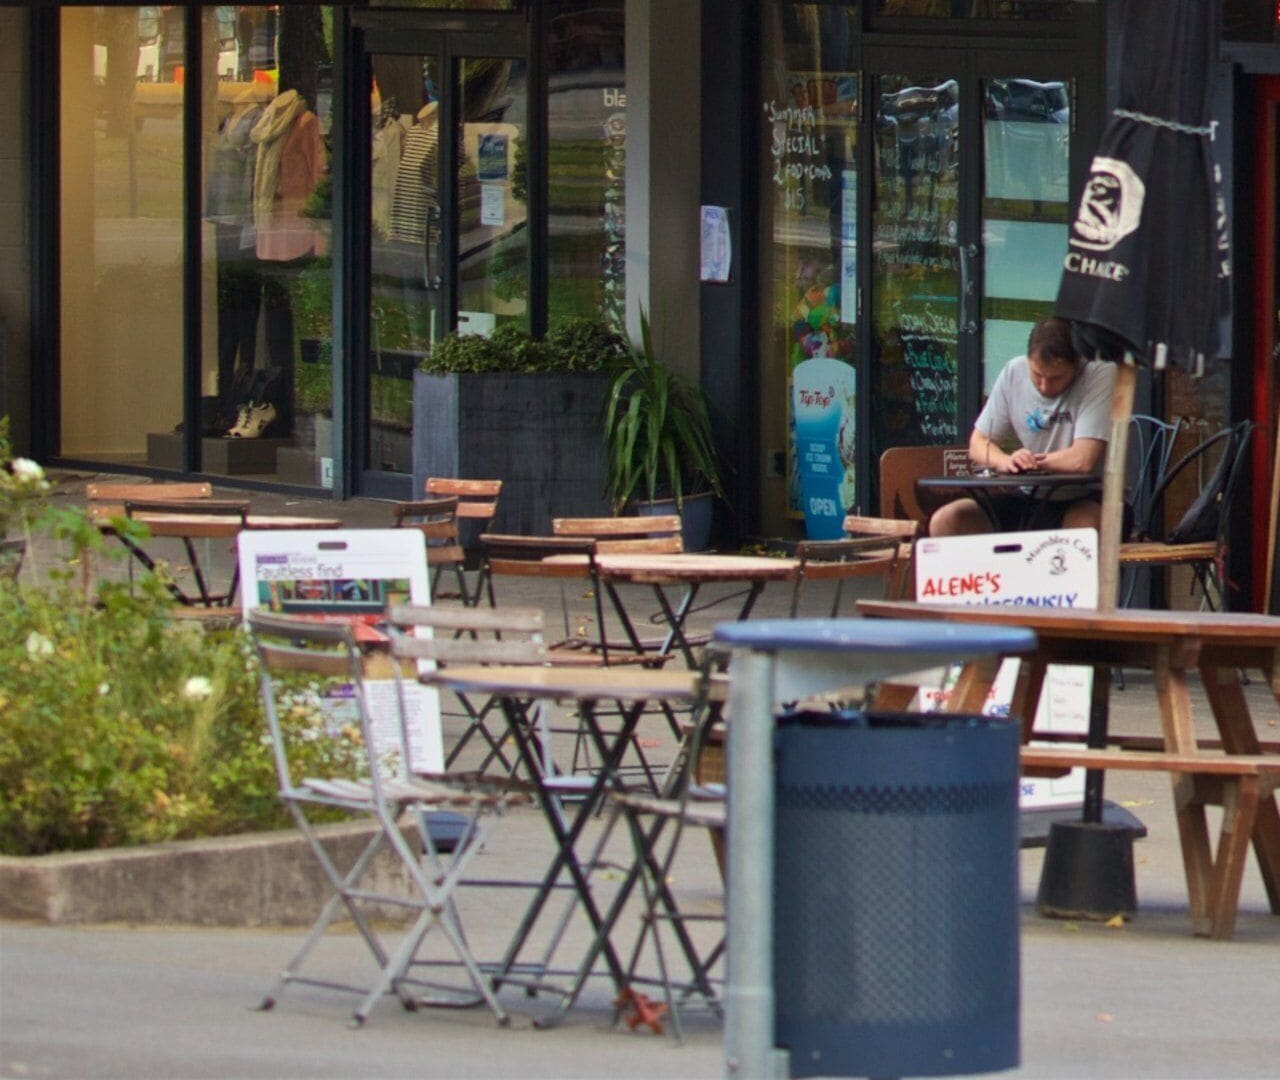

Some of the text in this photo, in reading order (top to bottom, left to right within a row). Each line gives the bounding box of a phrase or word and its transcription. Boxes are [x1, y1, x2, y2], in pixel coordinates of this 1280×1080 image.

[809, 497, 838, 517] OPEN
[1025, 534, 1092, 563] Mumbles Cafe
[256, 563, 344, 578] Faultless find
[922, 572, 1001, 597] ALENE'S
